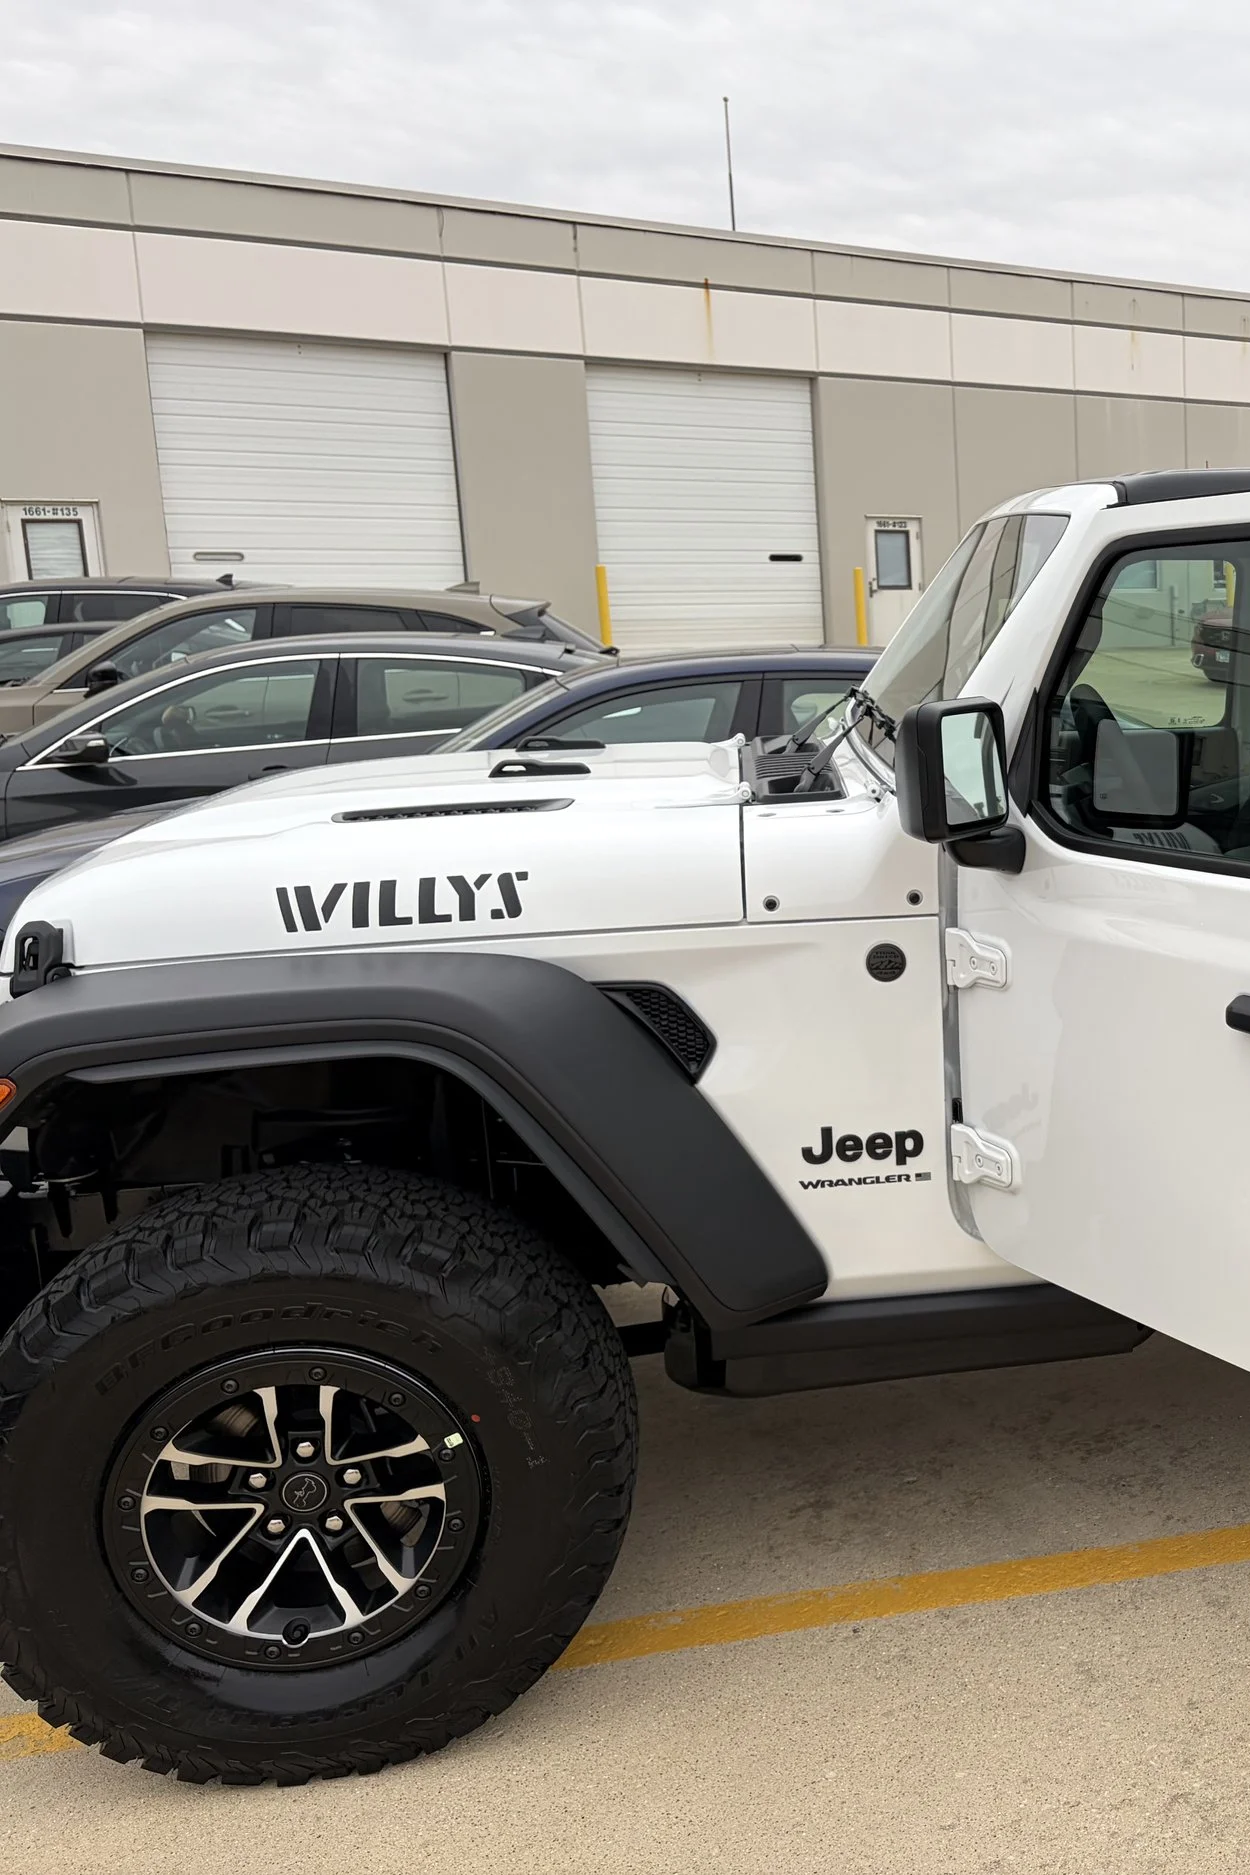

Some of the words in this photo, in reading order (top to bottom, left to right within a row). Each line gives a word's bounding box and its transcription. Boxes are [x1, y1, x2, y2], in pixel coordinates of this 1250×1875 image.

[22, 506, 79, 517] 1661-#135
[276, 871, 529, 933] WILLYS
[801, 1126, 924, 1166] Jeep
[799, 1173, 912, 1190] WRANGLER
[95, 1302, 443, 1396] BFGoodrich
